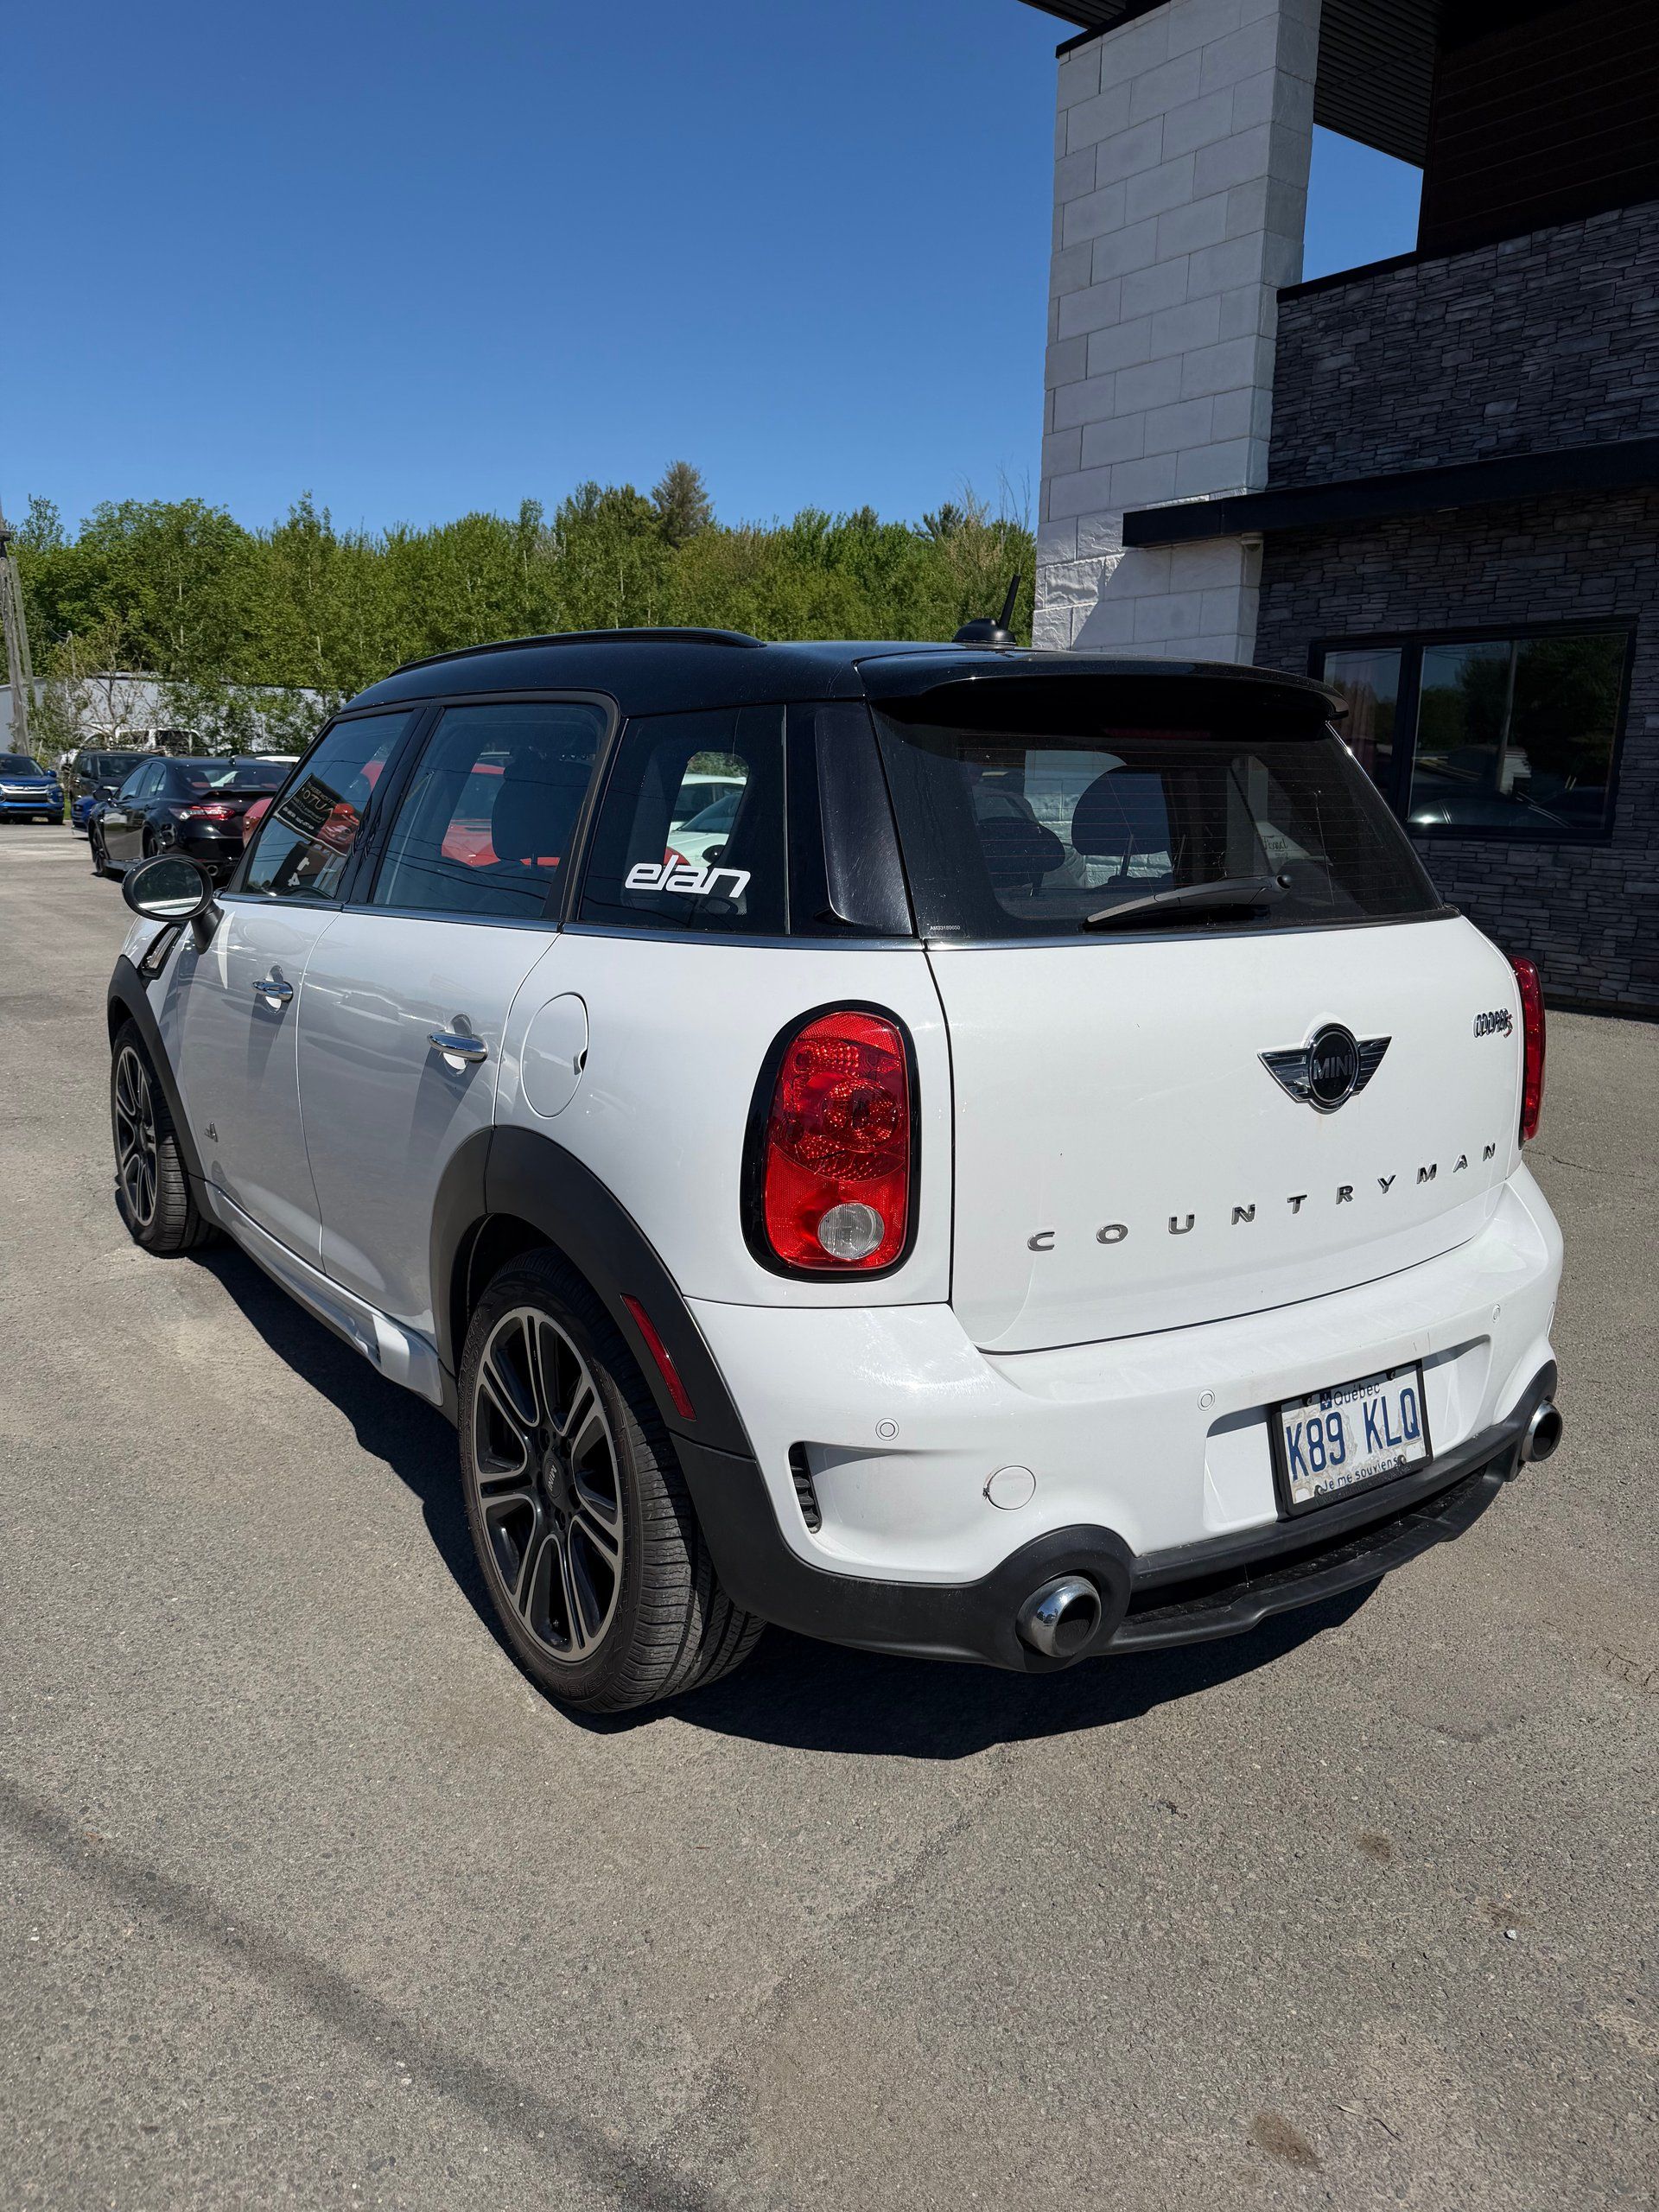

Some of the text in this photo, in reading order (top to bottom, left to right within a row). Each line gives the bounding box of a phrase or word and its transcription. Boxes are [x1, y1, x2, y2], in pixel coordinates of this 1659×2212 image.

[625, 855, 751, 899] elan
[1313, 1054, 1354, 1080] MINI
[1027, 1142, 1496, 1252] COUNTRYMAN
[1333, 1382, 1381, 1406] Québec
[1286, 1387, 1421, 1482] K89 KLQ
[1338, 1473, 1353, 1486] me
